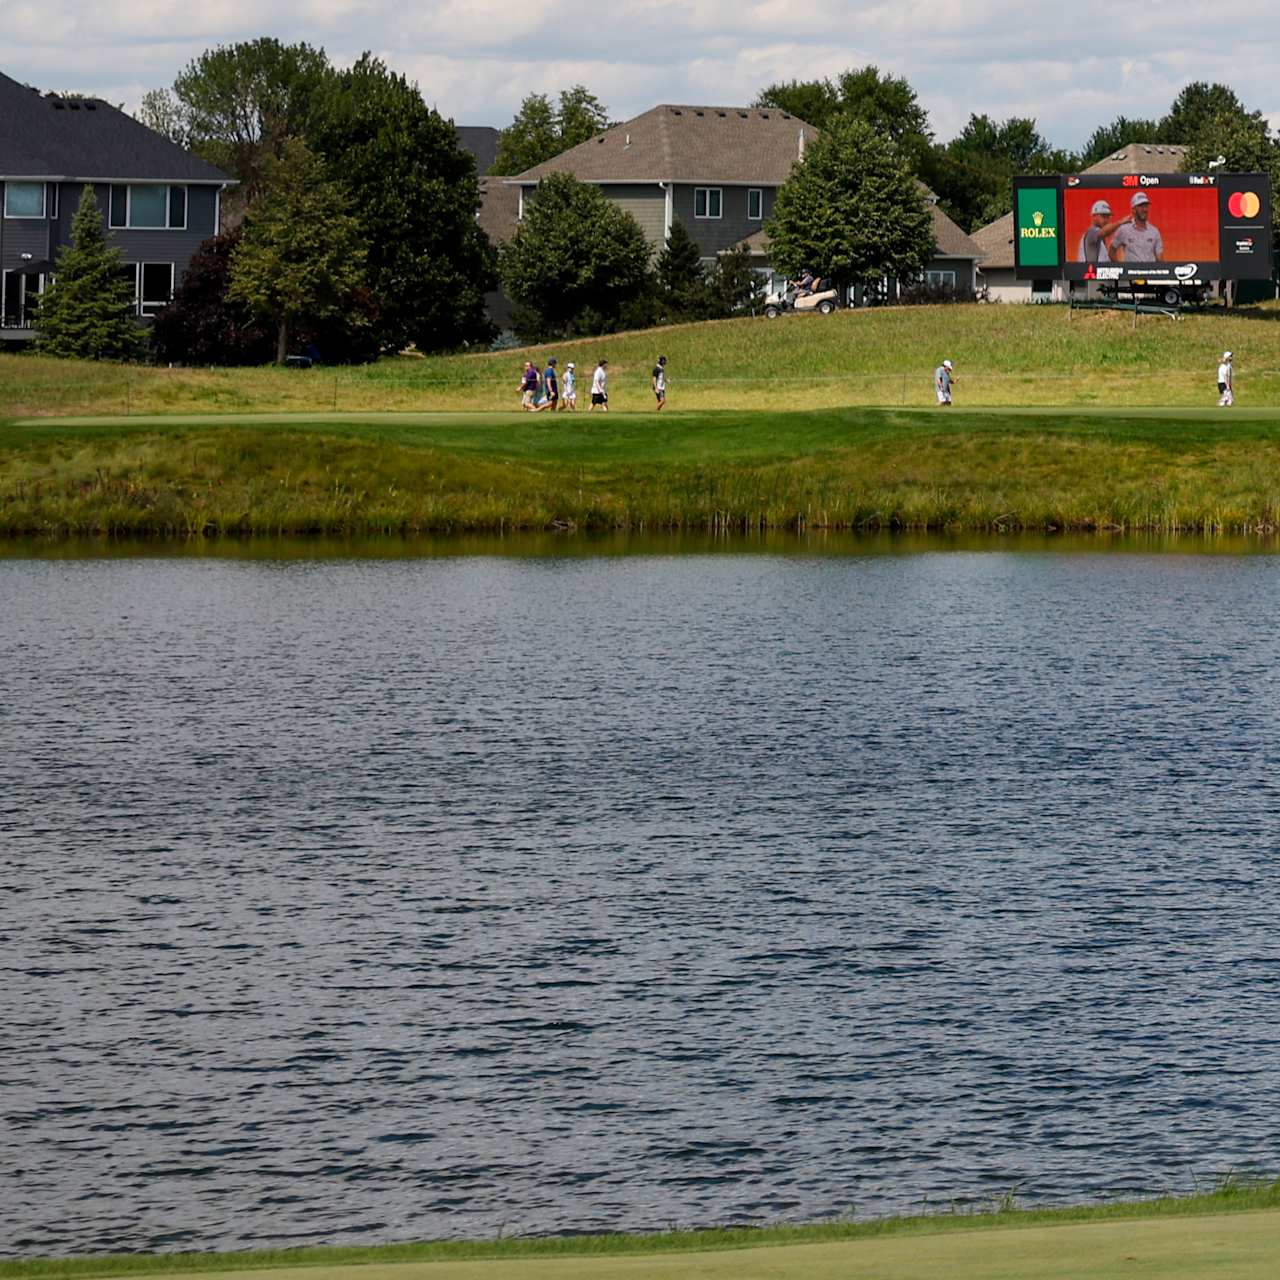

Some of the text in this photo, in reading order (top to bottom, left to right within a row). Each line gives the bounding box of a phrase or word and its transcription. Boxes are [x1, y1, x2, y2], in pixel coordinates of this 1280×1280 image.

[1122, 175, 1160, 186] 3M Open
[1021, 227, 1056, 238] ROLEX
